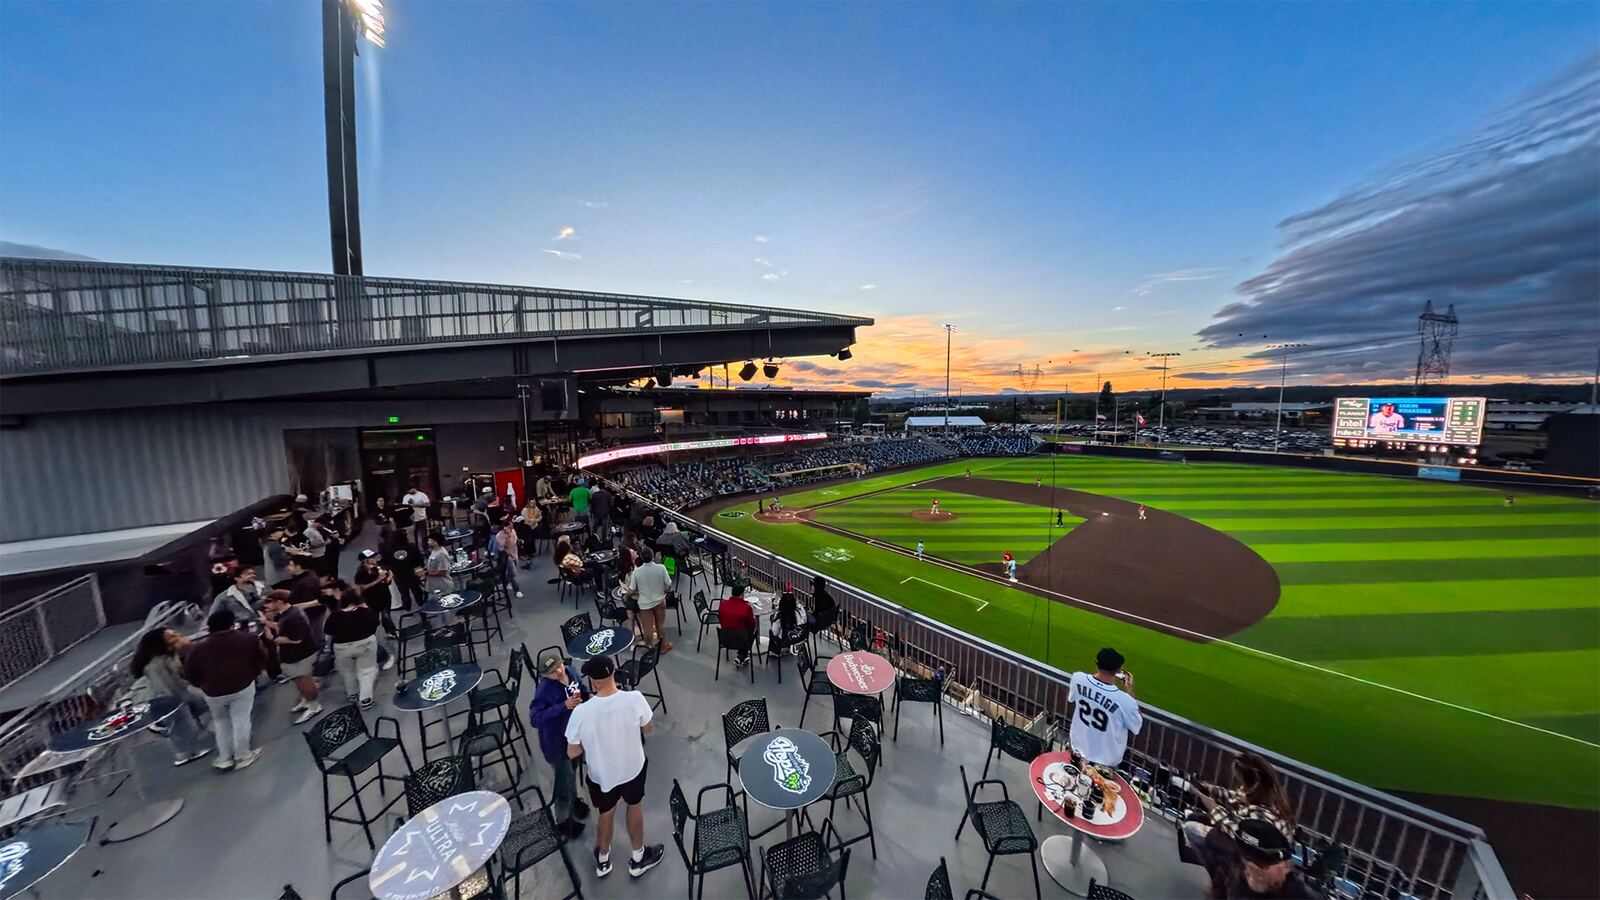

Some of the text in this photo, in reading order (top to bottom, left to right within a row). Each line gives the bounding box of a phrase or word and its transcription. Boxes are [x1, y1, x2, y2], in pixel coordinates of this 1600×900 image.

[1339, 419, 1363, 427] intel
[844, 654, 868, 690] Budweiser
[1077, 683, 1119, 713] RALEIGH
[1079, 699, 1109, 732] 29
[425, 816, 457, 862] ULTRA
